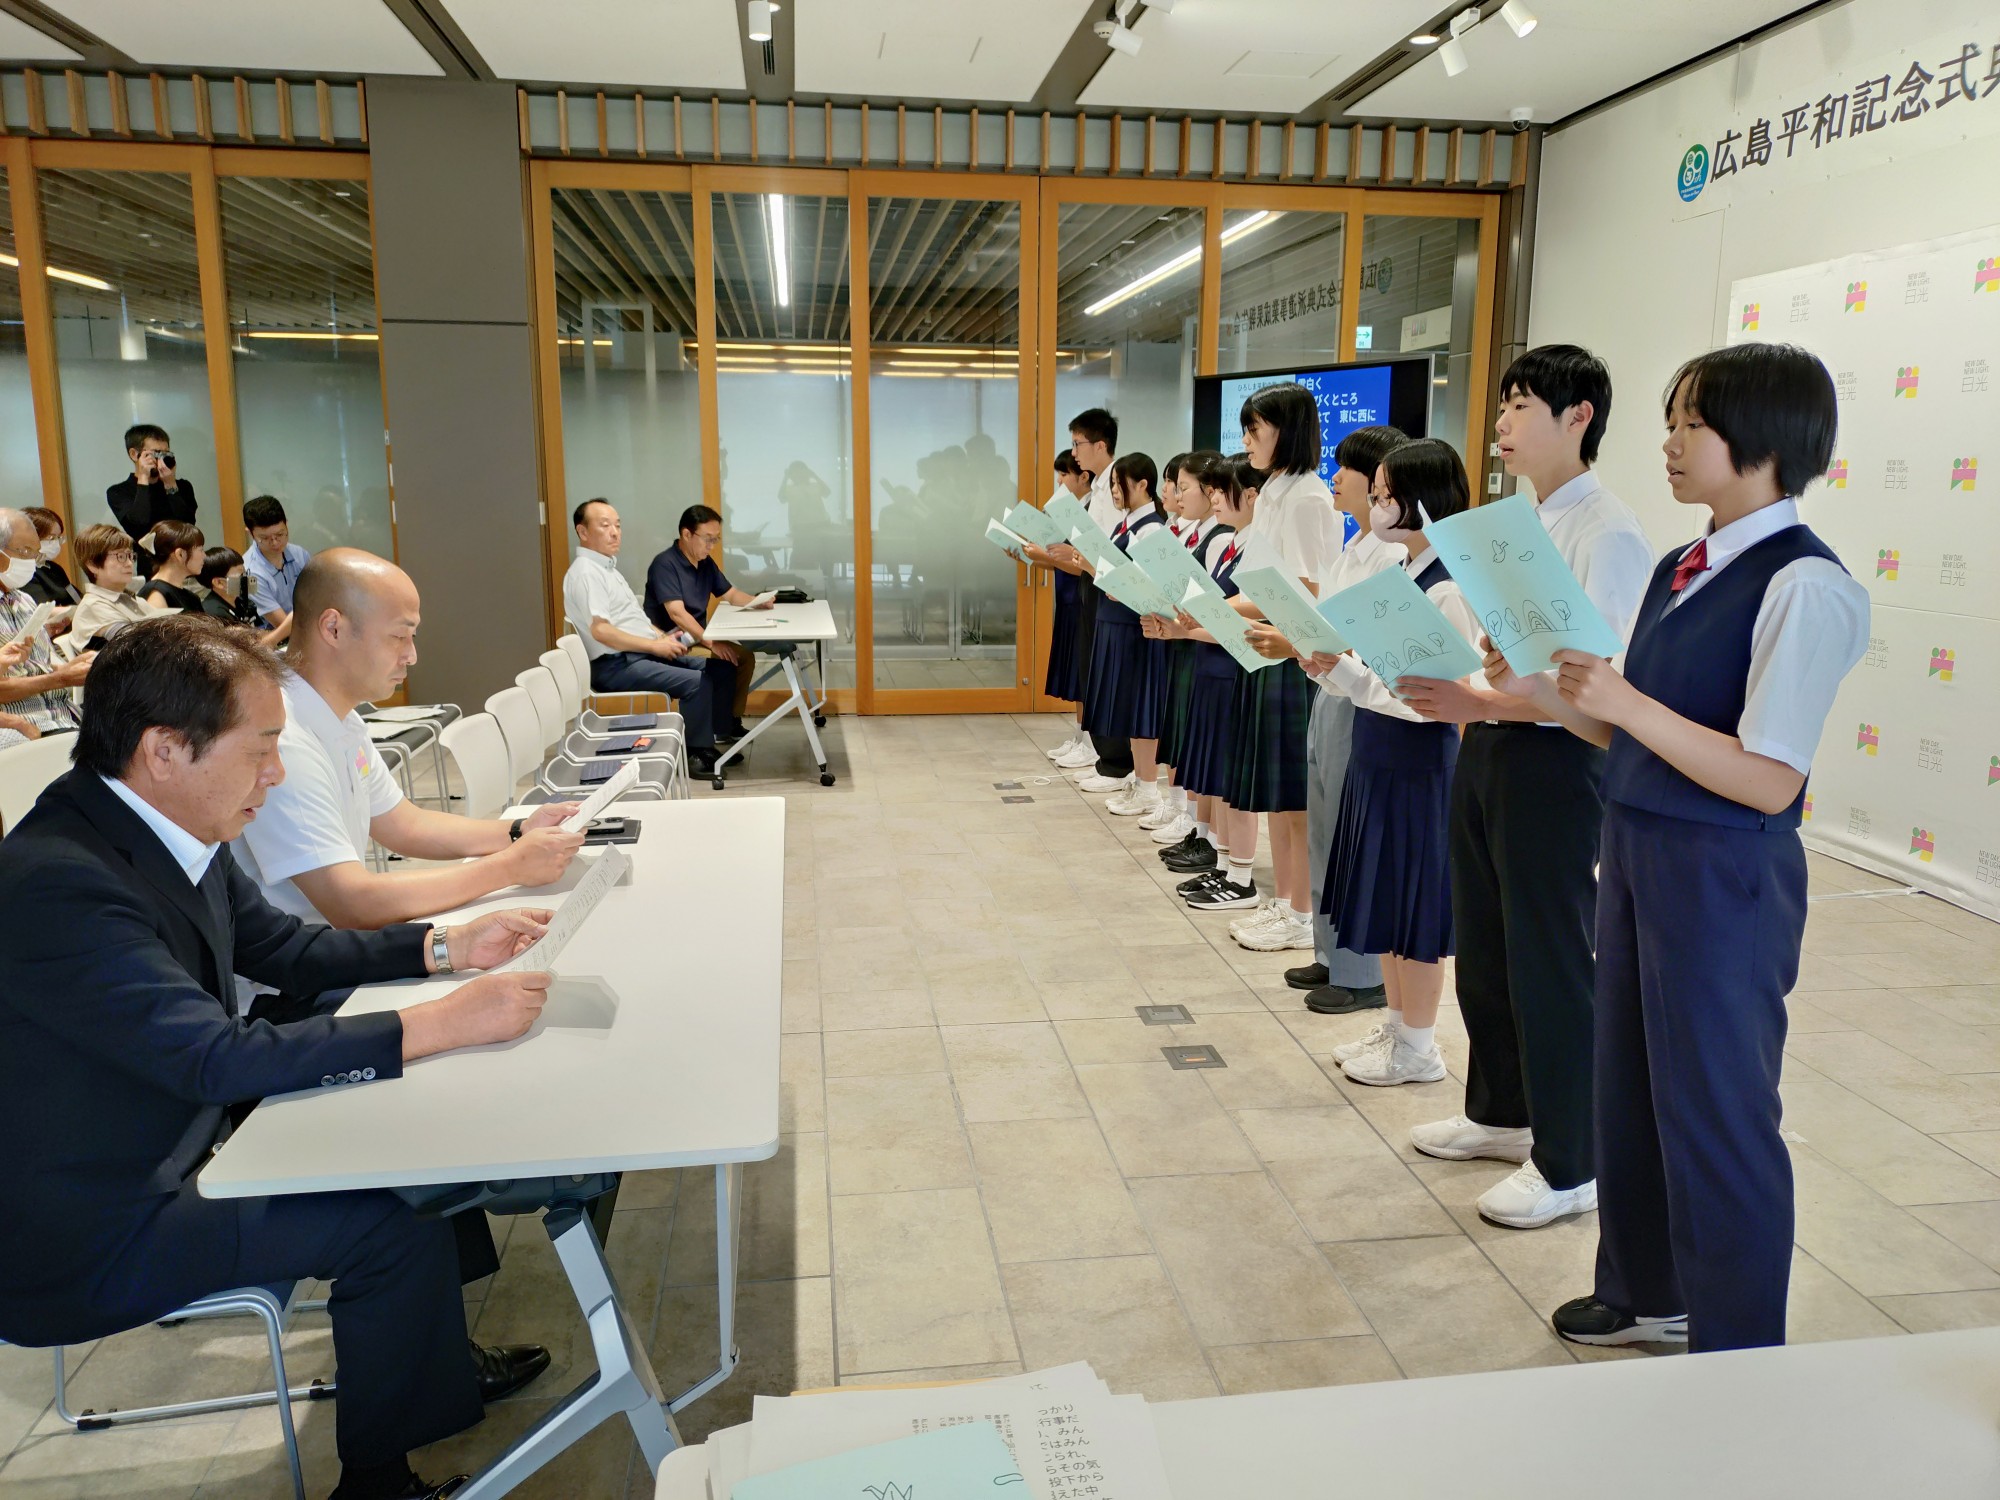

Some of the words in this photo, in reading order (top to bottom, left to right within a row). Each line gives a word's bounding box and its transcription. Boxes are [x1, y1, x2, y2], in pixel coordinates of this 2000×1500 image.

[1904, 287, 1929, 304] 日光
[1790, 307, 1809, 323] 日光
[1961, 374, 1988, 393] 日光
[1836, 385, 1857, 401] 日光
[1340, 408, 1376, 424] 東に西に
[1885, 474, 1908, 490] 日光
[1940, 569, 1966, 586] 日光
[1865, 651, 1888, 668] 日光
[1918, 753, 1943, 773] 日光
[1848, 820, 1871, 840] 日光
[1975, 865, 2000, 889] 日光
